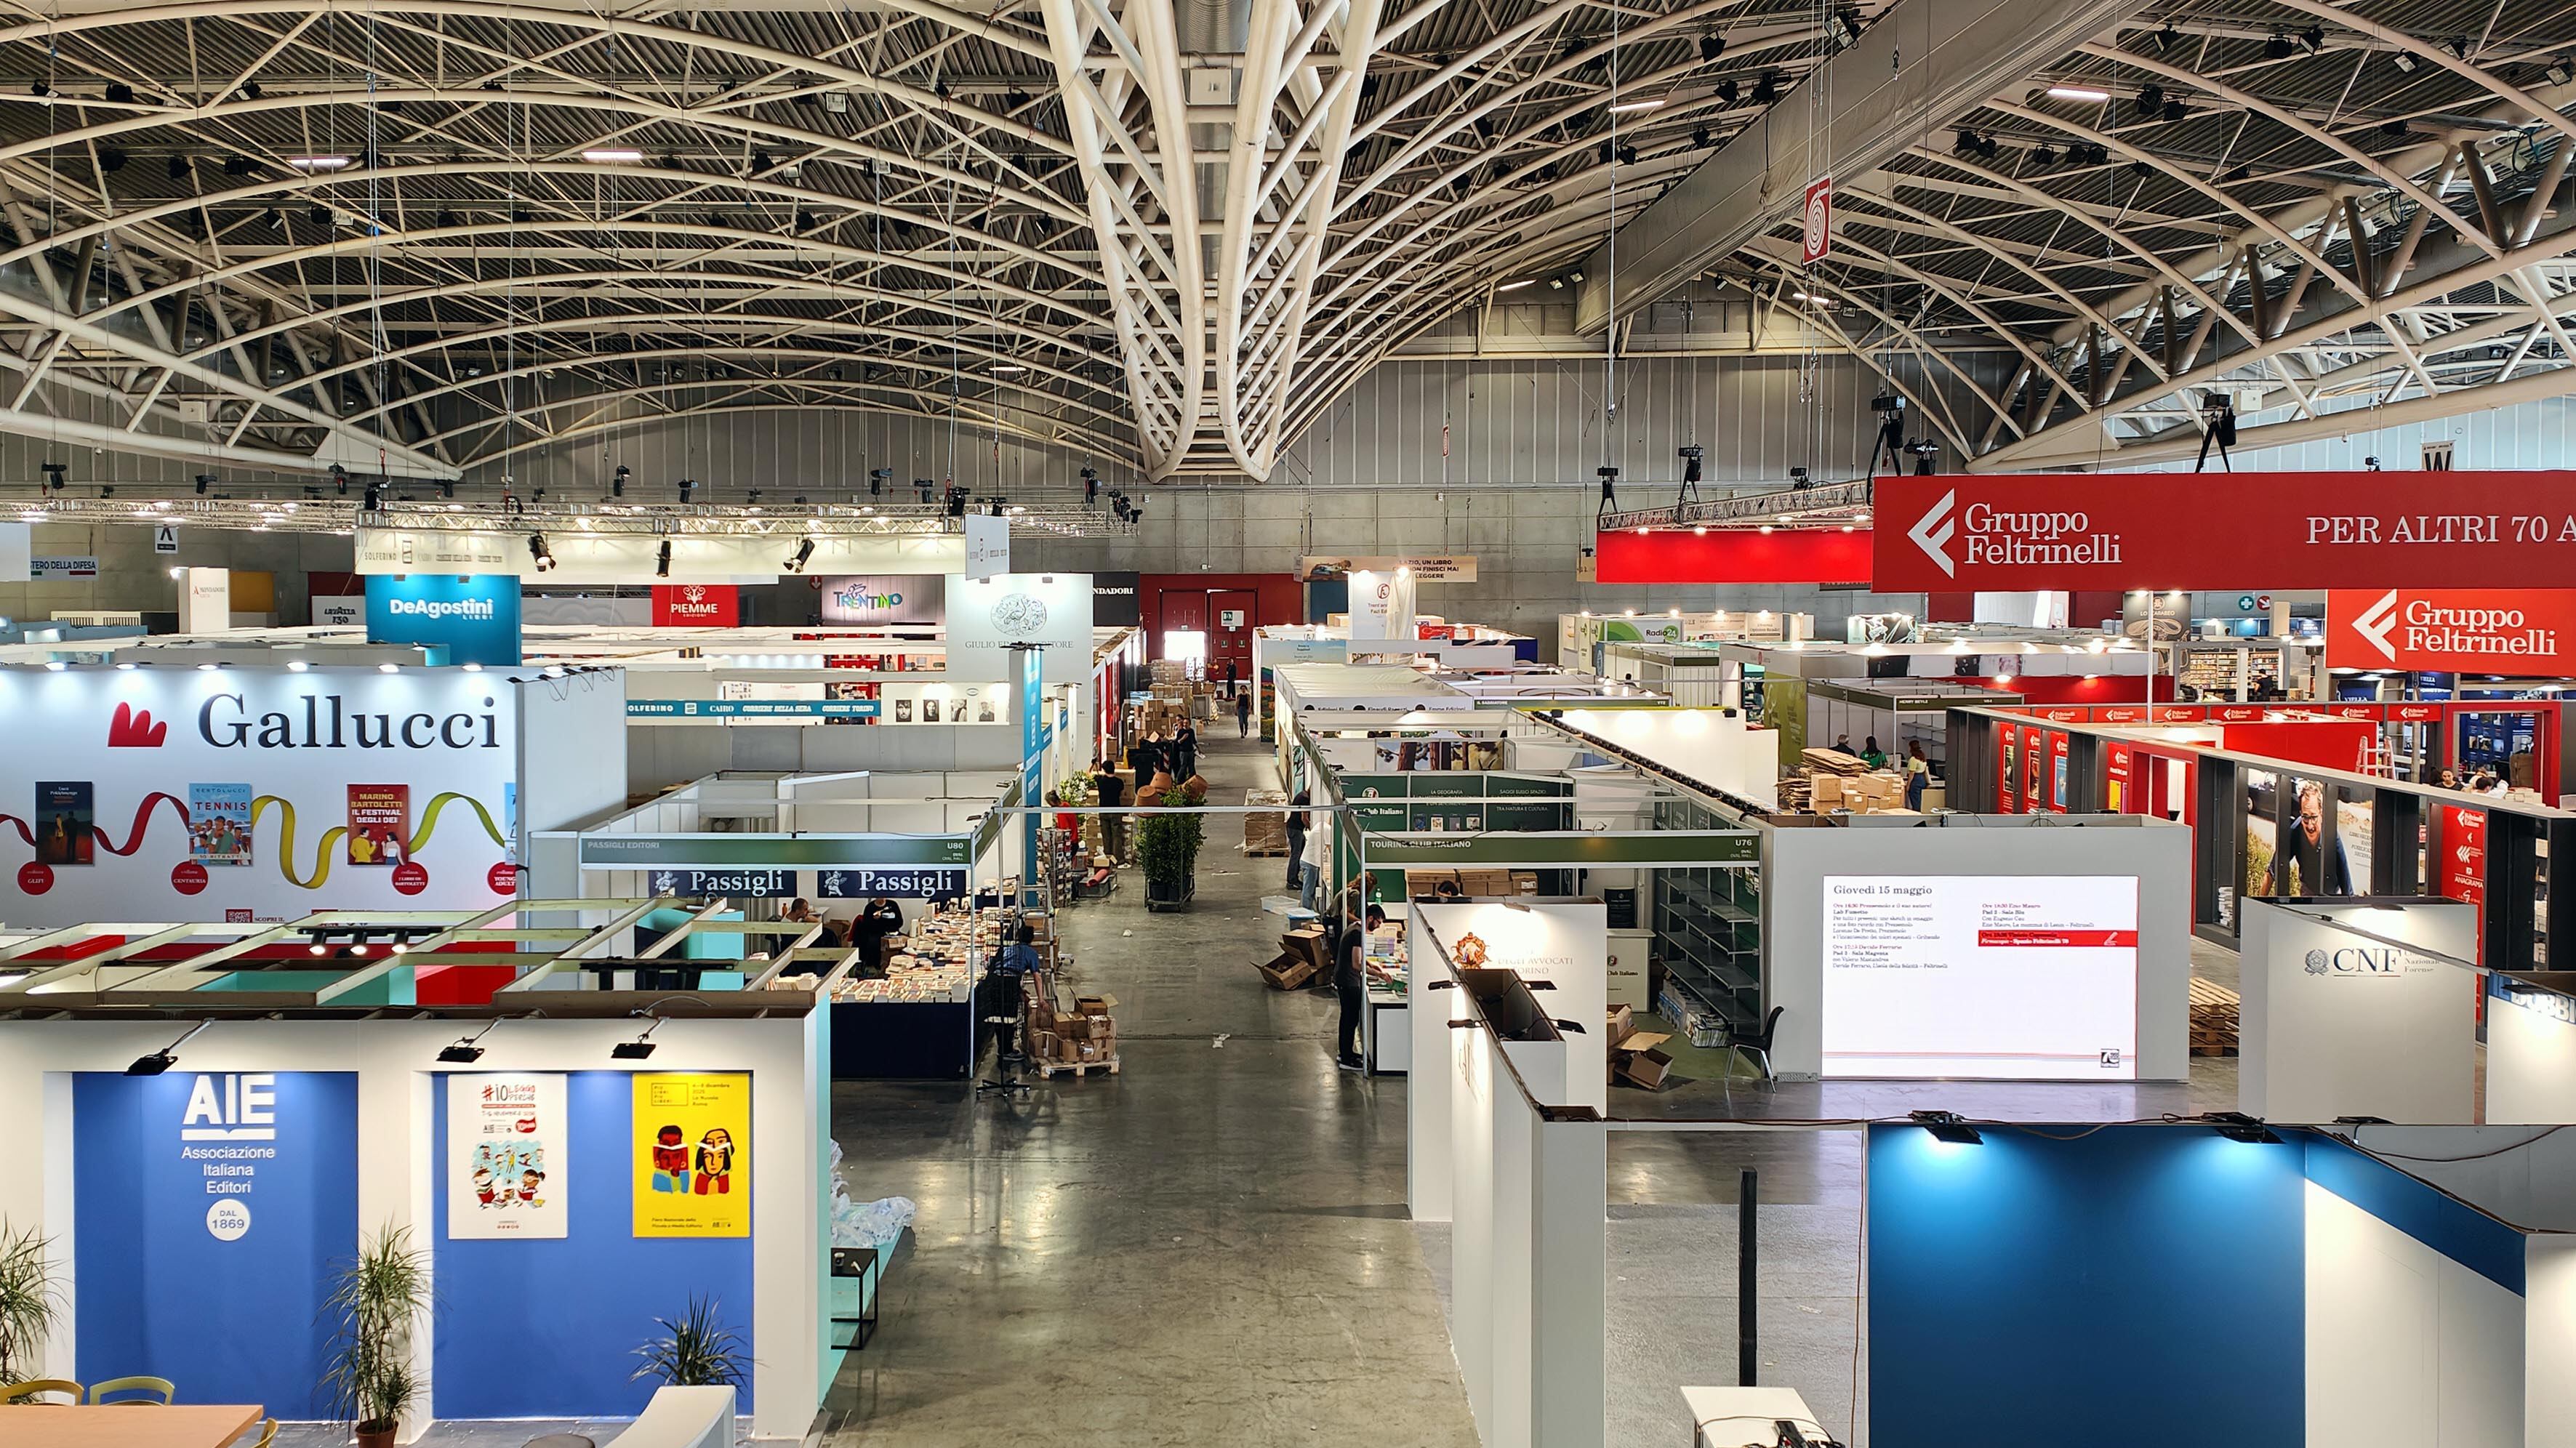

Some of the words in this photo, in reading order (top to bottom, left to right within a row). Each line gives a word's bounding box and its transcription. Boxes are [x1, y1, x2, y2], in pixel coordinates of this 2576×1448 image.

[1965, 503, 2088, 540] Gruppo
[2306, 517, 2381, 544] PER
[2389, 515, 2500, 543] ALTRI
[2511, 516, 2548, 542] 70
[1964, 534, 2122, 564] Feltrinelli
[31, 560, 50, 570] TERO
[51, 560, 72, 570] DELLA
[73, 560, 96, 570] DIFESA
[324, 606, 356, 615] LAVAZZA
[390, 598, 494, 619] DeAgostini
[670, 604, 718, 614] PIEMME
[833, 591, 903, 610] TRENTINO
[2405, 600, 2524, 633] Gruppo
[2404, 627, 2558, 656] Feltrinelli
[198, 693, 500, 749] Gallucci
[195, 802, 246, 811] TENNIS
[690, 869, 785, 897] Passigli
[859, 870, 953, 897] Passigli
[1834, 885, 1874, 894] Giovedì
[1879, 885, 1890, 894] 15
[1893, 885, 1933, 896] maggio
[2333, 948, 2401, 973] CNF
[182, 1074, 275, 1125] AIE
[181, 1146, 275, 1159] Associazione
[203, 1163, 254, 1176] Italiana
[206, 1180, 252, 1194] Editori
[212, 1219, 245, 1229] 1869
